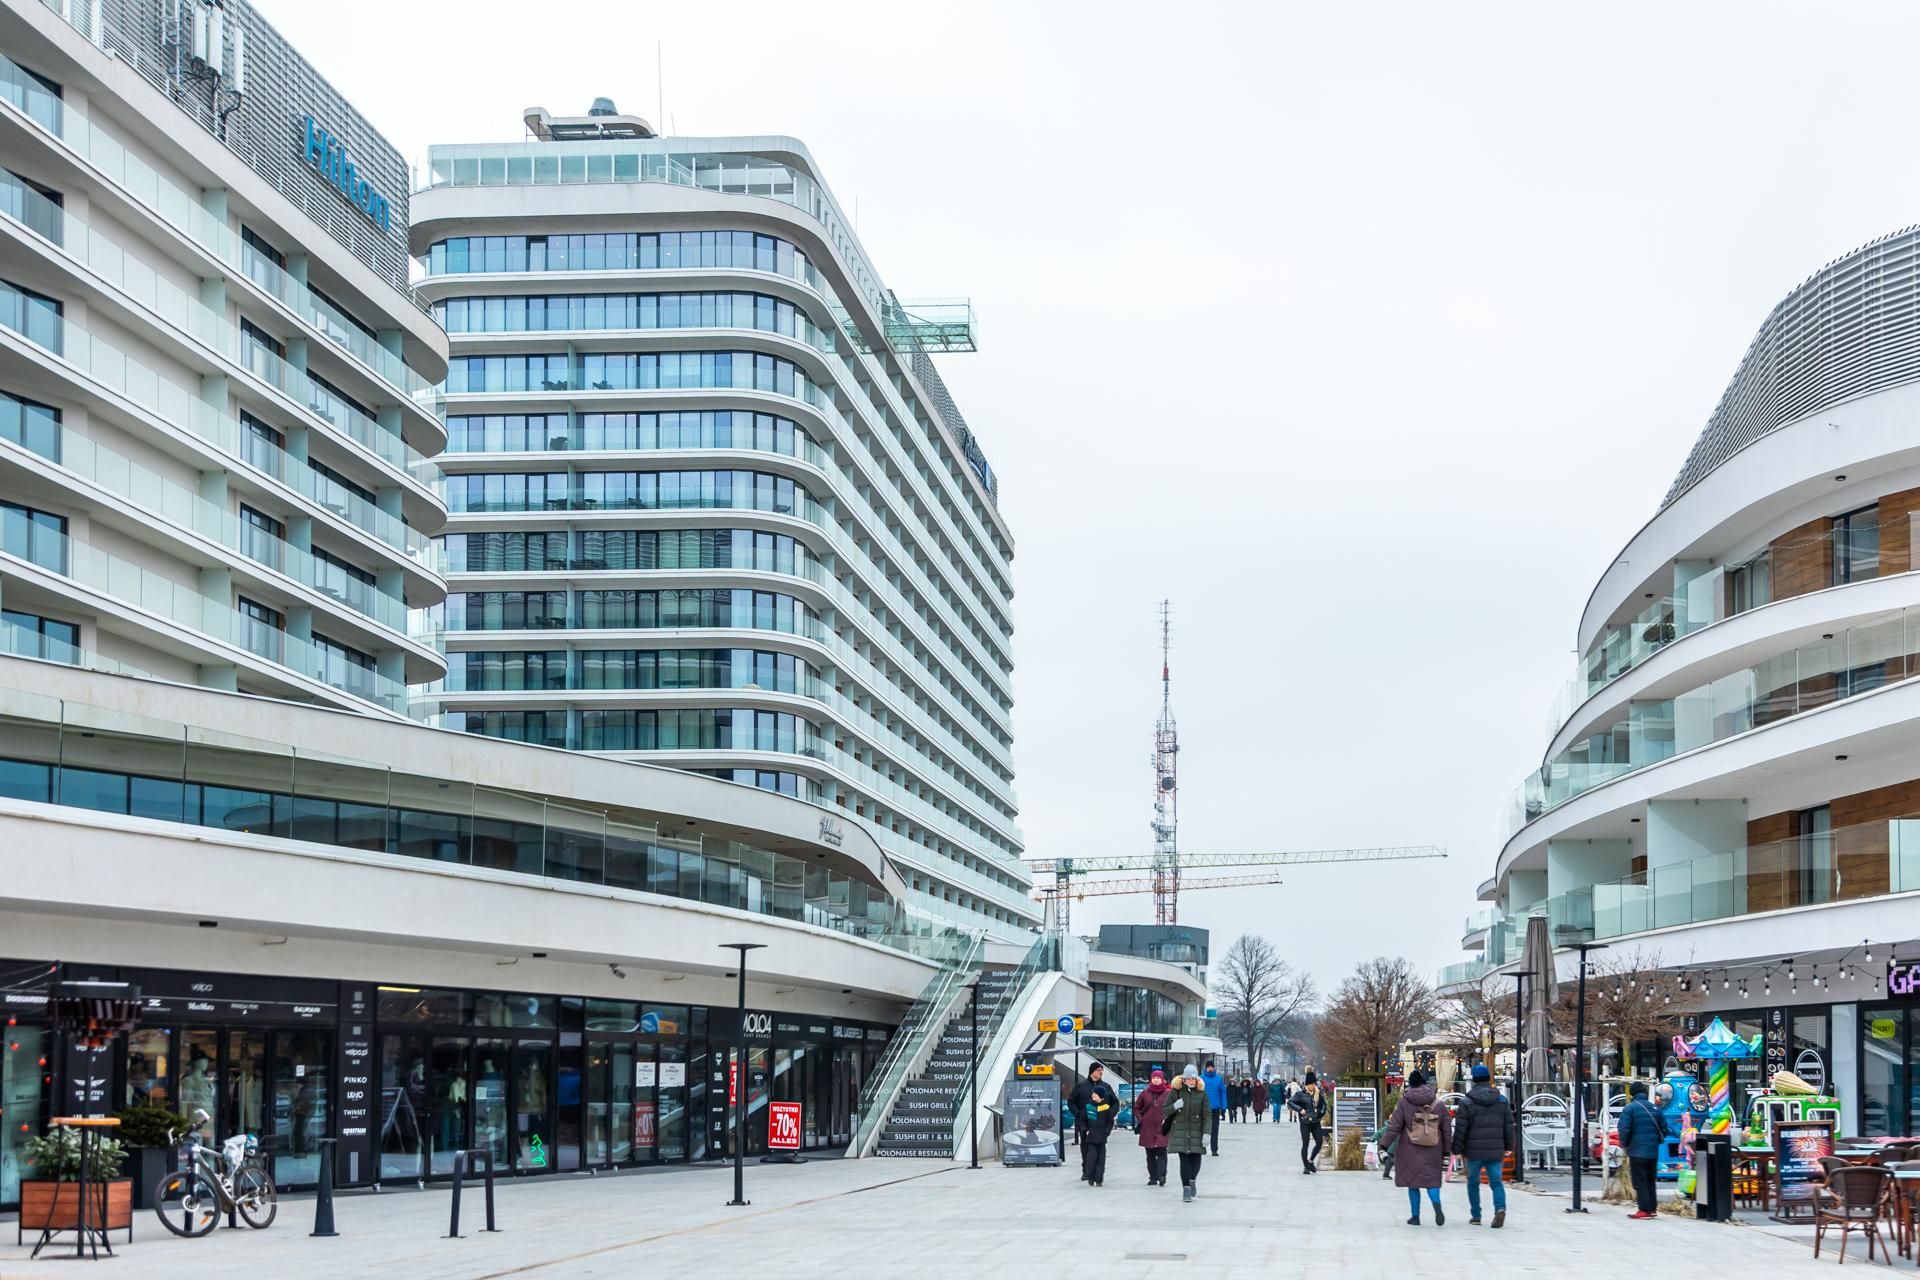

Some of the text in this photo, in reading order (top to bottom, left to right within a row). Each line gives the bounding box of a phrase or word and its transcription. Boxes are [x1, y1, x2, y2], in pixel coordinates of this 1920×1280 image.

[300, 112, 390, 232] Hilton
[1117, 1037, 1174, 1051] RESTAURANT
[343, 1076, 368, 1084] PINKO
[905, 1087, 943, 1095] POLONAISE
[771, 1113, 798, 1138] -70%
[771, 1137, 797, 1145] ALLES
